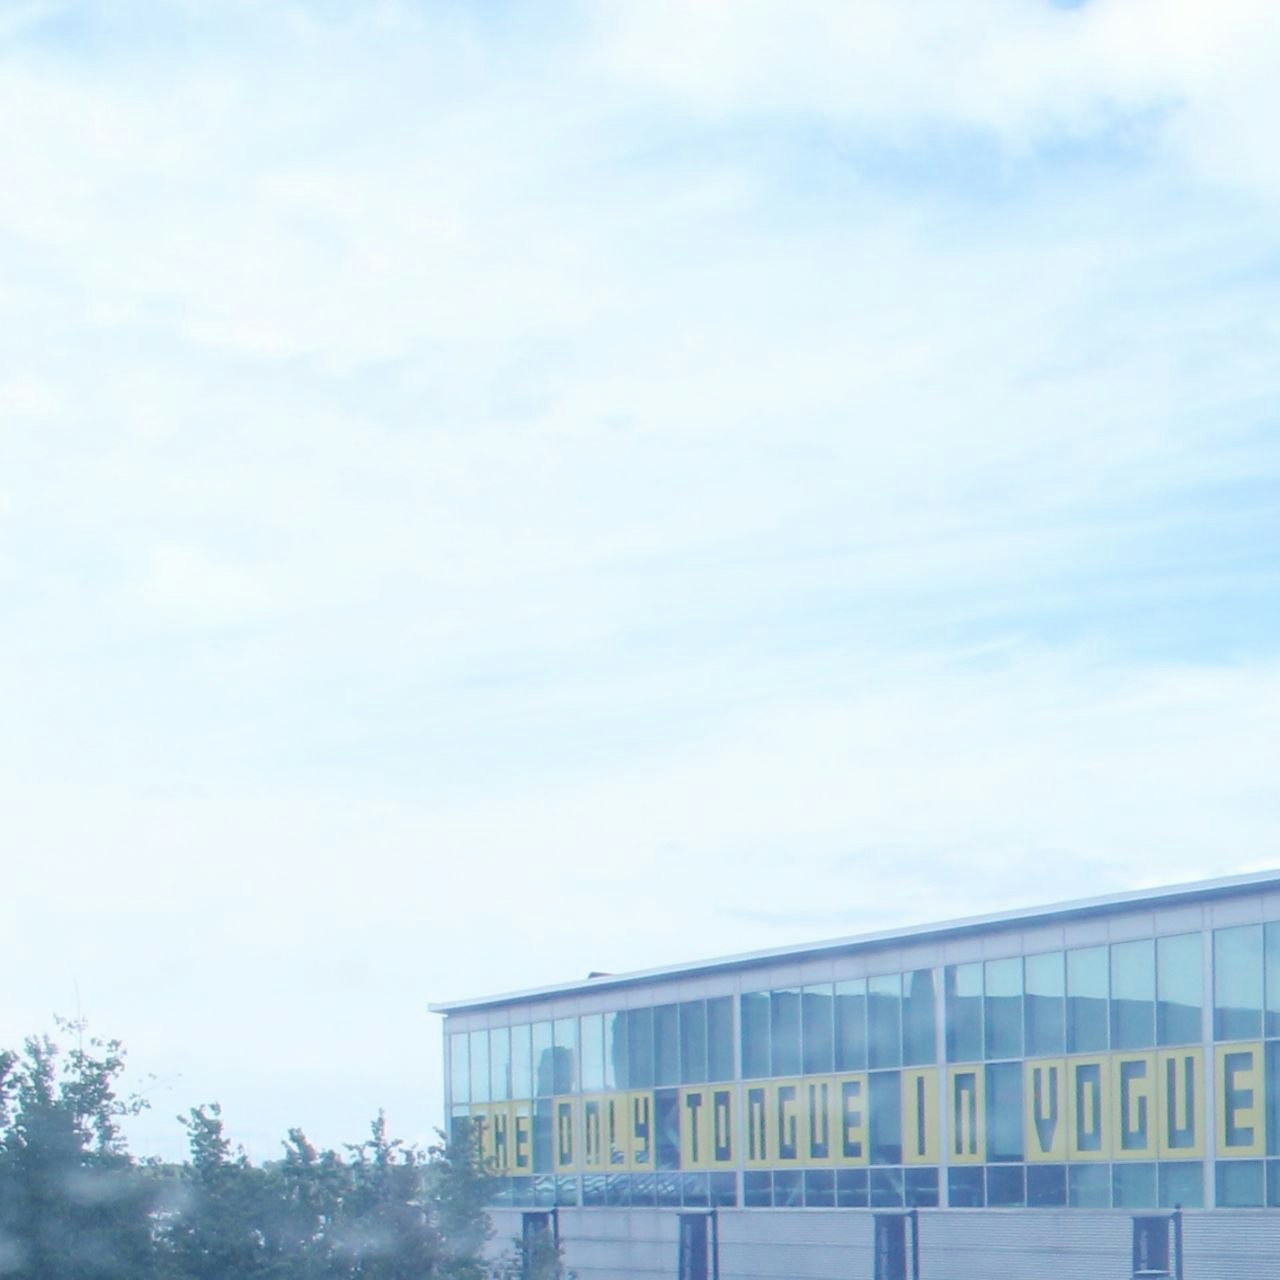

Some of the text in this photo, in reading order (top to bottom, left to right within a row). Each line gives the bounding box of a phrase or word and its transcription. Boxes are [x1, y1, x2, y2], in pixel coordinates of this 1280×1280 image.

[474, 1052, 1256, 1169] THE ONLY TONGUE IN VOGUE
